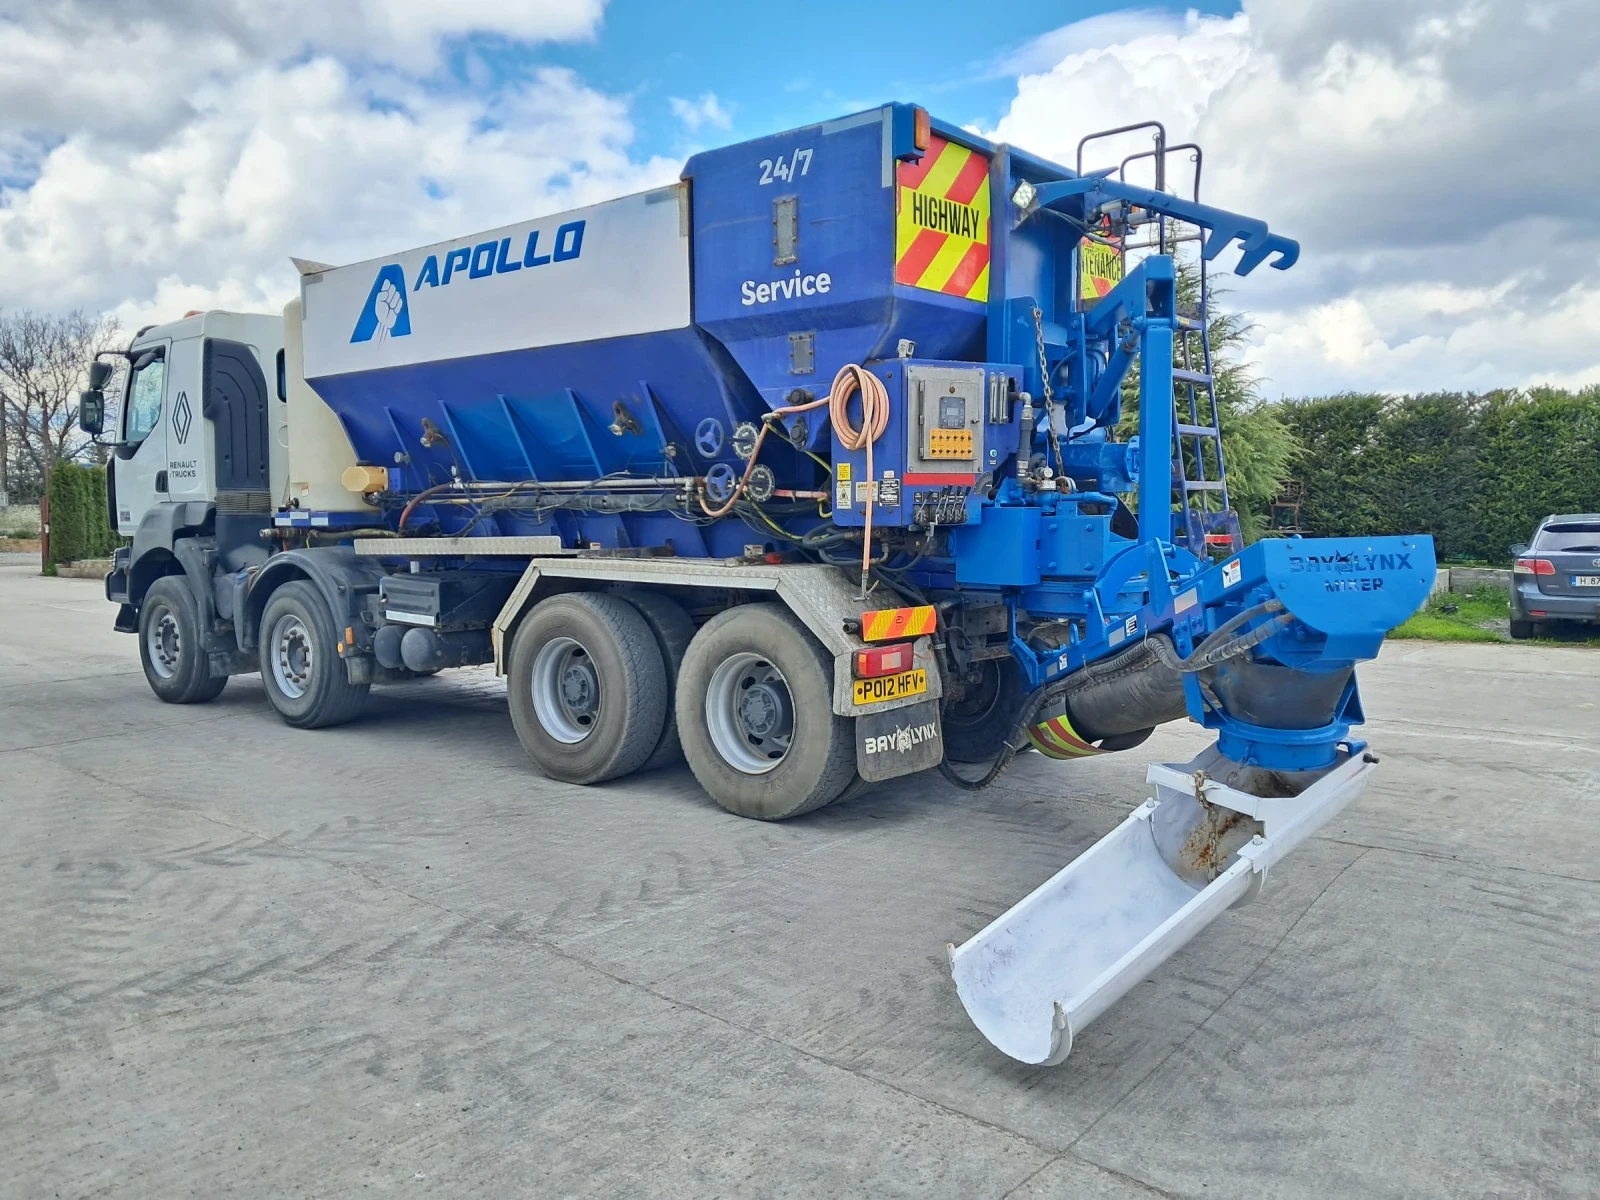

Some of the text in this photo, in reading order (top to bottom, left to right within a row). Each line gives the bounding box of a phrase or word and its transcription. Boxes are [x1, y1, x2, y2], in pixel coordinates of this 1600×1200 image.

[758, 148, 813, 186] 24/7
[912, 191, 979, 240] HIGHWAY
[413, 219, 586, 292] APOLLO
[741, 269, 831, 306] Service
[169, 460, 197, 469] RENAULT
[171, 470, 197, 478] TRUCKS
[1289, 553, 1413, 573] BAY LYNX
[1325, 578, 1384, 592] MIXER
[1580, 577, 1587, 585] H
[863, 672, 919, 699] PO12 HFV
[865, 722, 938, 754] BAY LYNX
